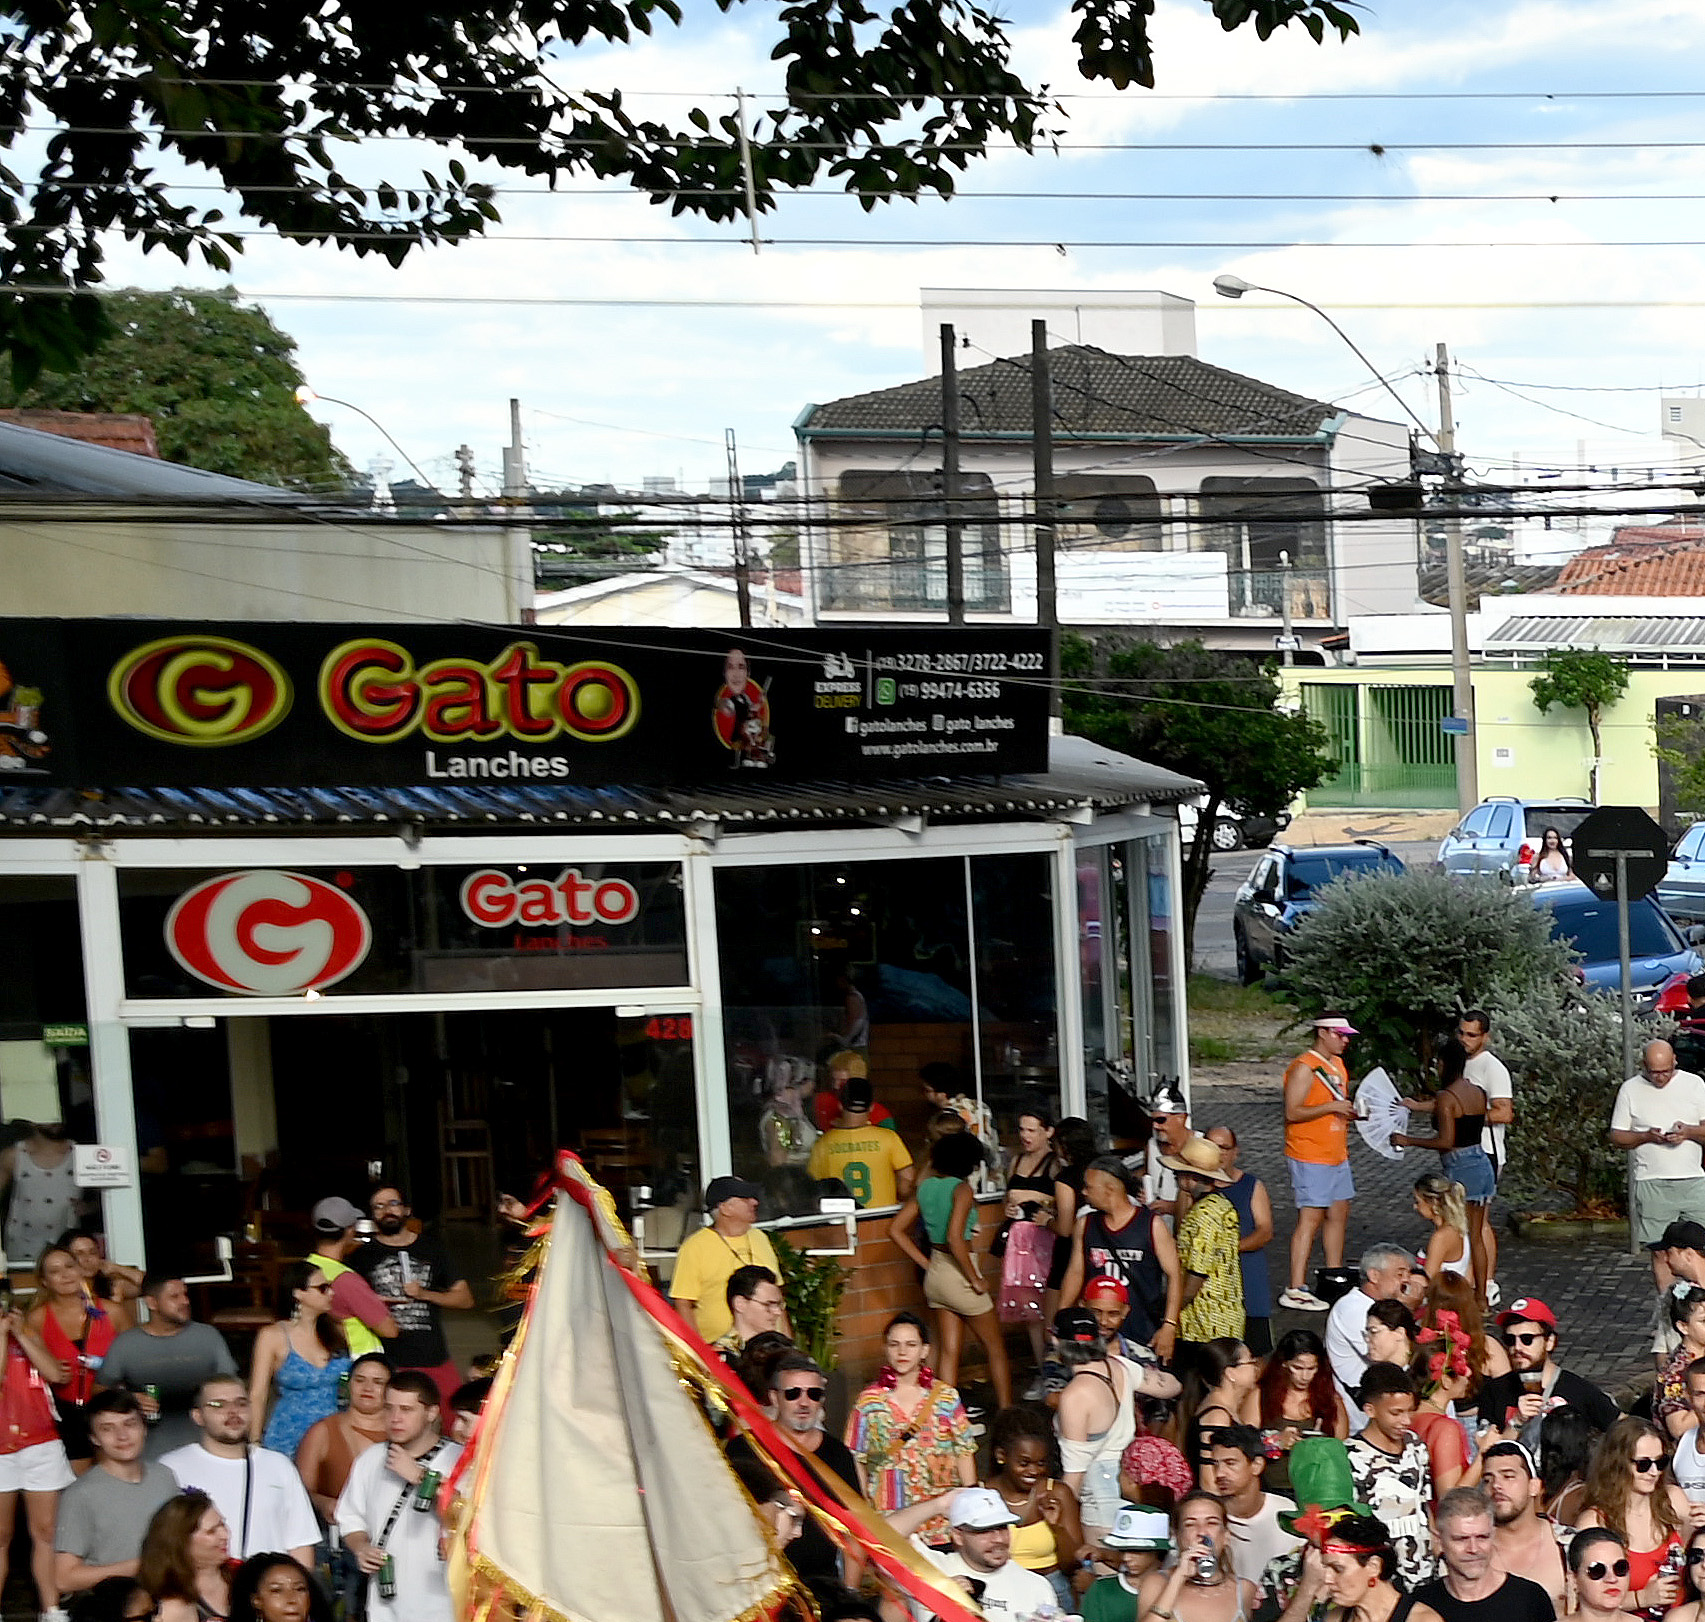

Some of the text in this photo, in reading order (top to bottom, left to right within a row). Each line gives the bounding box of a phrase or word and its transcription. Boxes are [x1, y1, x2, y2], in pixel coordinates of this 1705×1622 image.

[321, 640, 638, 741] Gato
[426, 749, 570, 778] Lanches
[461, 868, 639, 928] Gato
[843, 1161, 872, 1205] 8
